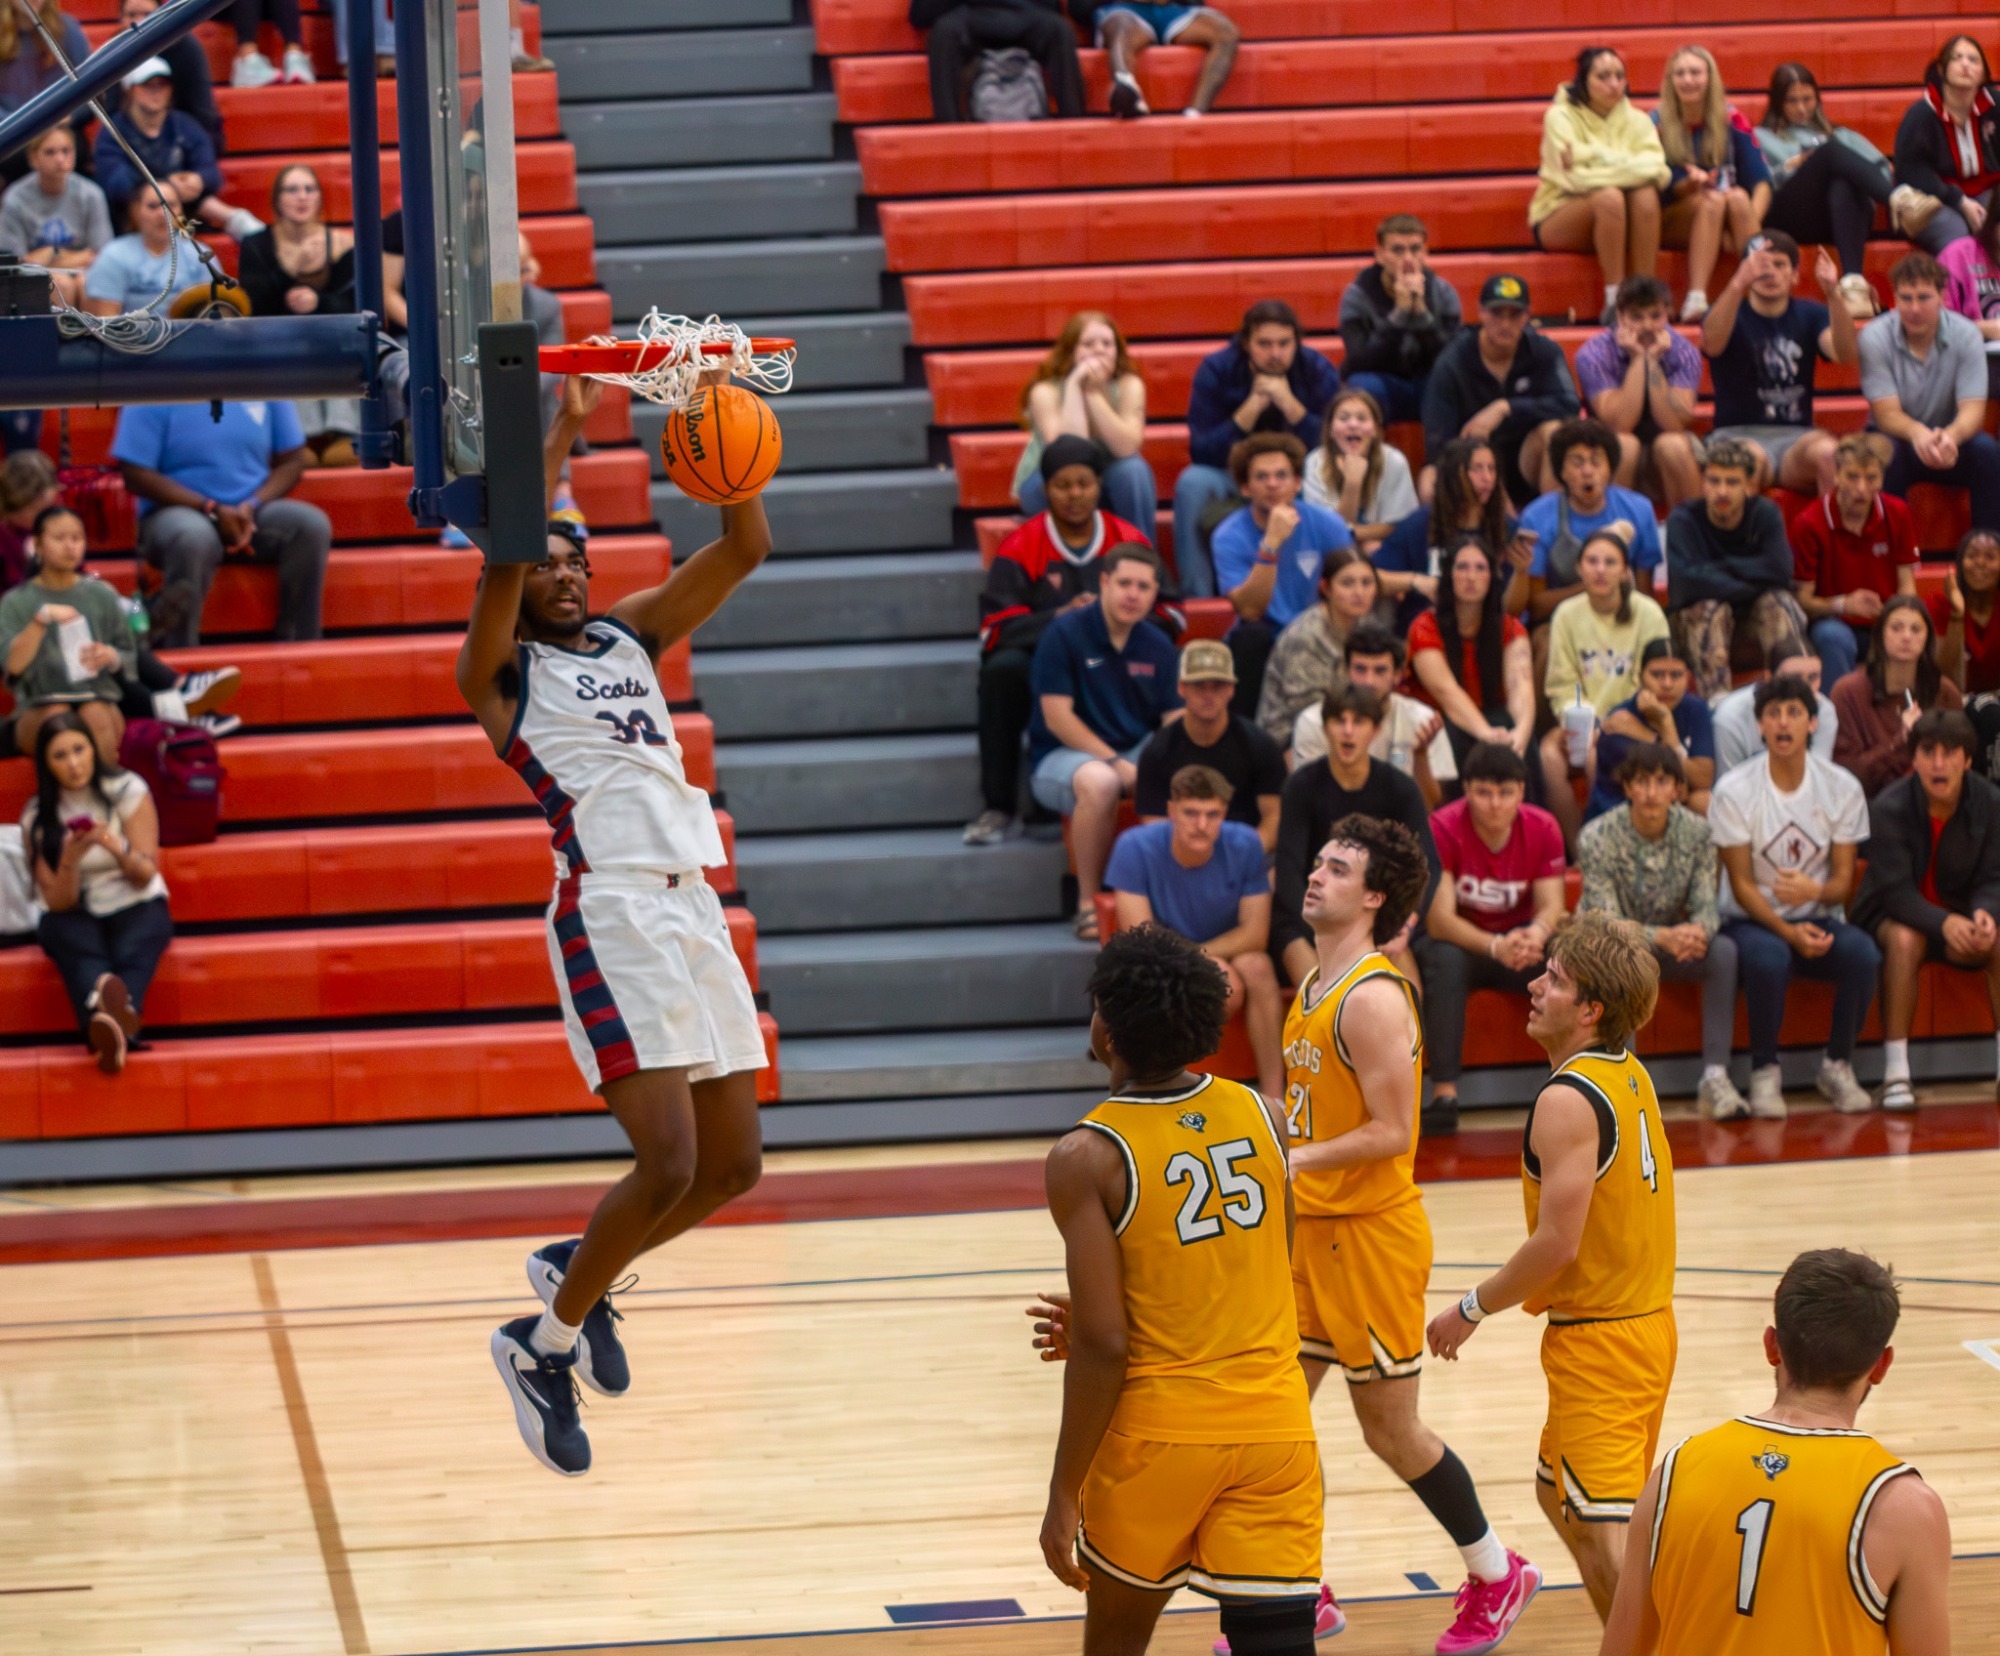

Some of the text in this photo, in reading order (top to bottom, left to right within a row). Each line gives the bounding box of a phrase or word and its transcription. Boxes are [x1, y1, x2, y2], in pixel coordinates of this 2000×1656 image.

[686, 390, 706, 462] Wilson
[576, 674, 649, 701] Scots
[1286, 1082, 1313, 1140] 21
[1639, 1108, 1658, 1194] 4
[1164, 1136, 1268, 1246] 25
[1735, 1498, 1775, 1617] 1
